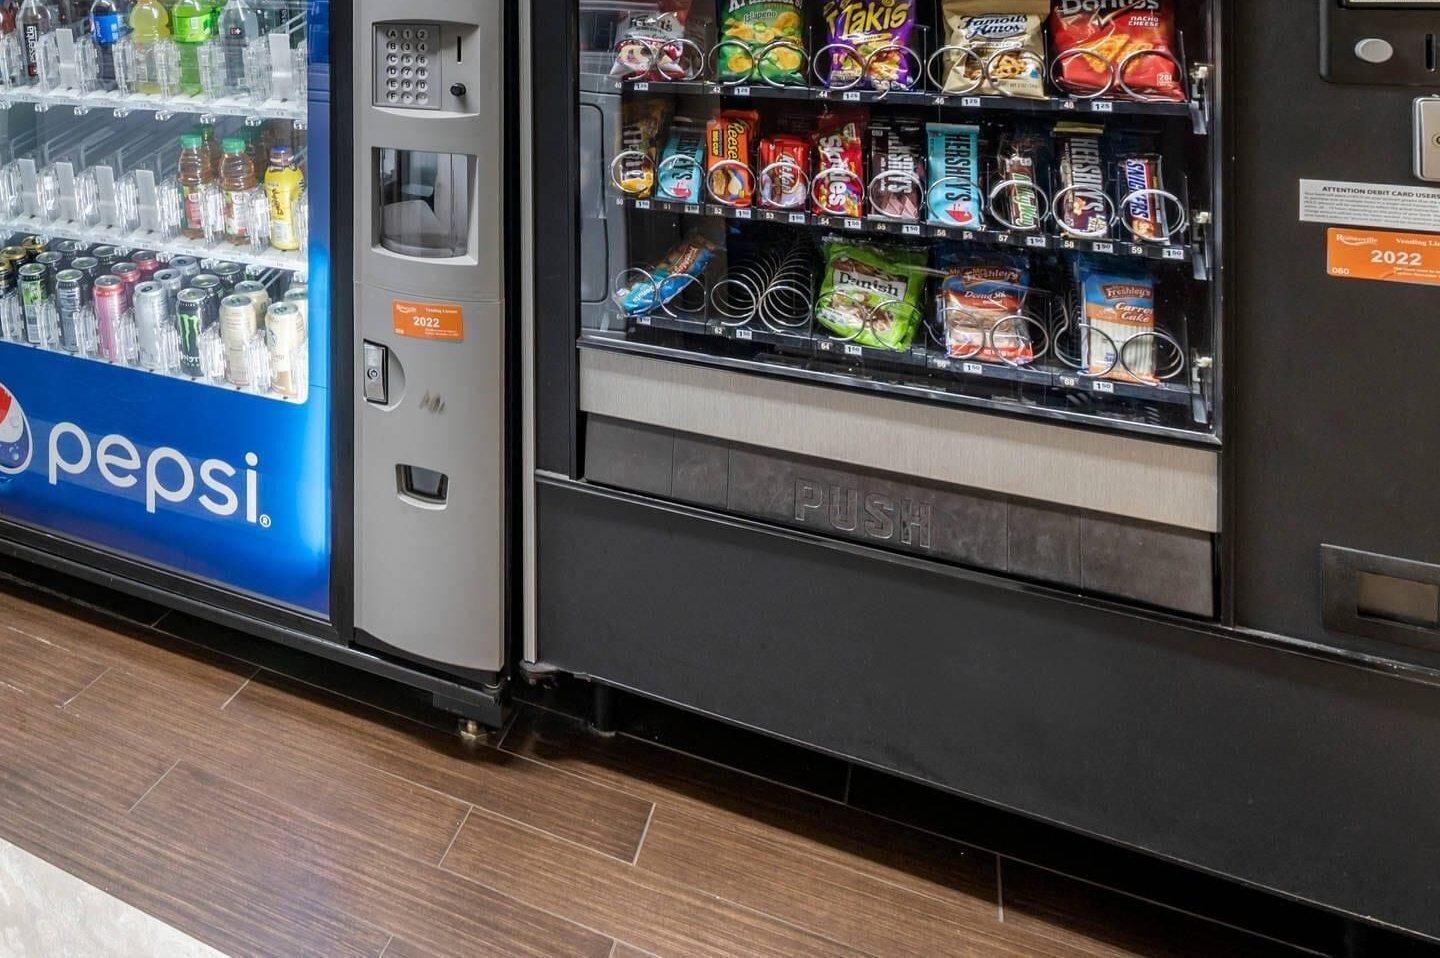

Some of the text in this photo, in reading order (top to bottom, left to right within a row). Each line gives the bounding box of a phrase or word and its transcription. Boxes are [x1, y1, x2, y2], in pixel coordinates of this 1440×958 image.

[744, 9, 777, 24] Jalapeño
[959, 14, 1028, 30] Famous
[965, 23, 1025, 39] Amos
[26, 25, 38, 63] essentia
[820, 135, 848, 206] Skittles
[945, 133, 972, 202] HERSHEY'S
[1322, 186, 1365, 195] ATTENTION
[1396, 238, 1427, 247] Vending
[1371, 250, 1422, 266] 2022
[839, 271, 900, 297] Danish
[1107, 287, 1153, 297] Freshley's
[413, 315, 440, 328] 2022
[1121, 311, 1150, 323] Cake
[48, 421, 258, 523] pepsi
[794, 478, 933, 549] PUSH
